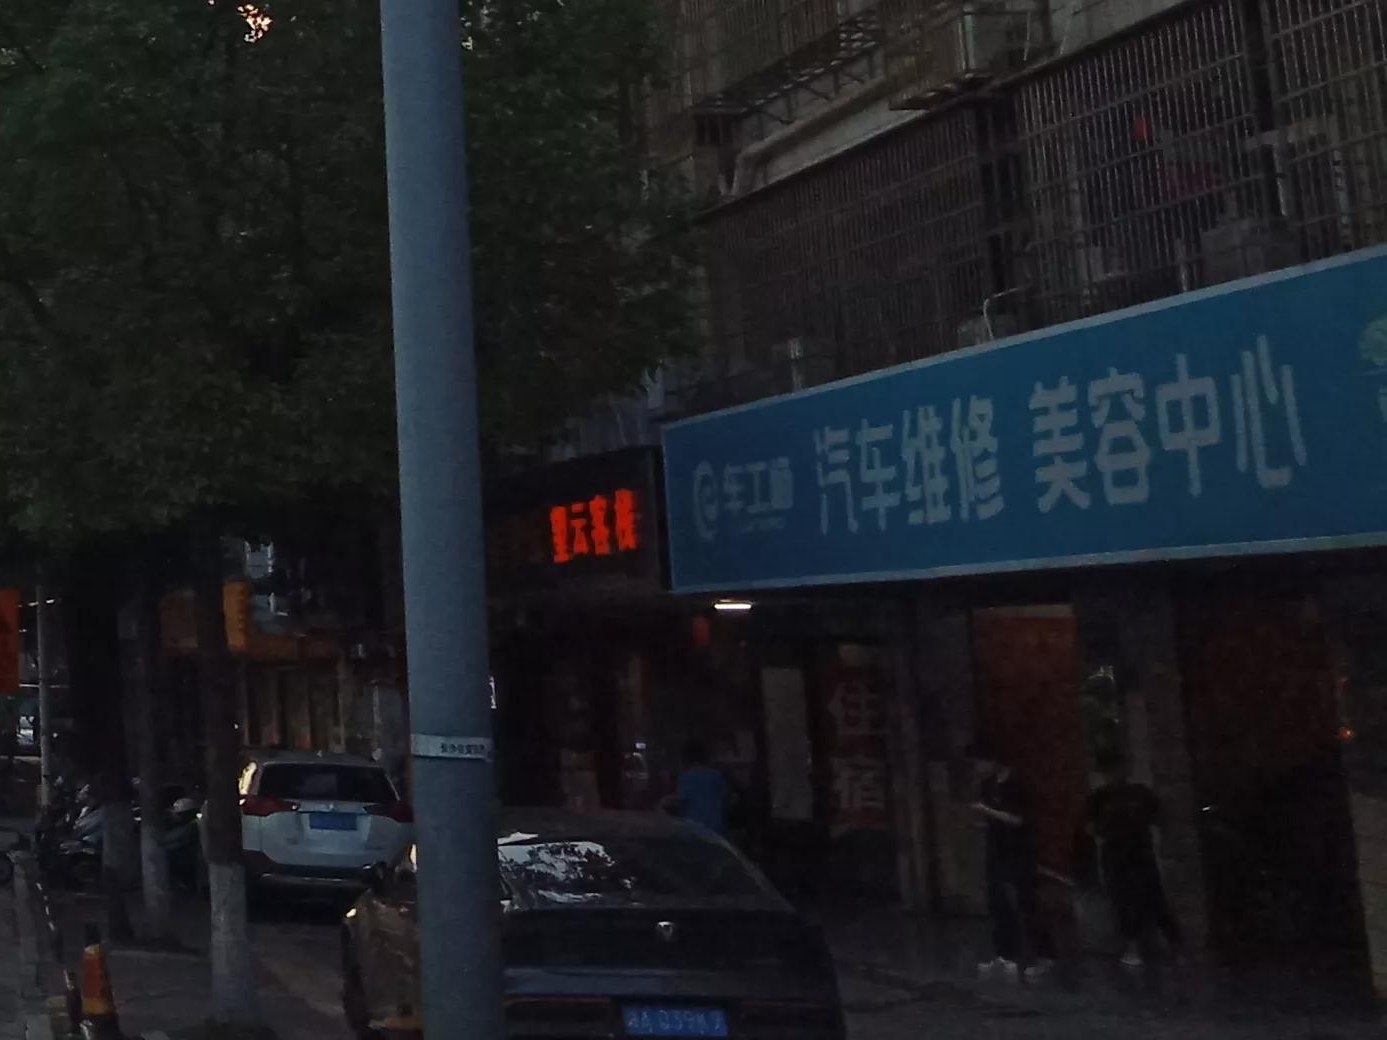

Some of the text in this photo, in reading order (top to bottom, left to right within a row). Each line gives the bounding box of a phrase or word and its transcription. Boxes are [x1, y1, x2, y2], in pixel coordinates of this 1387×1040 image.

[813, 334, 1309, 535] 汽车维修 美容中心
